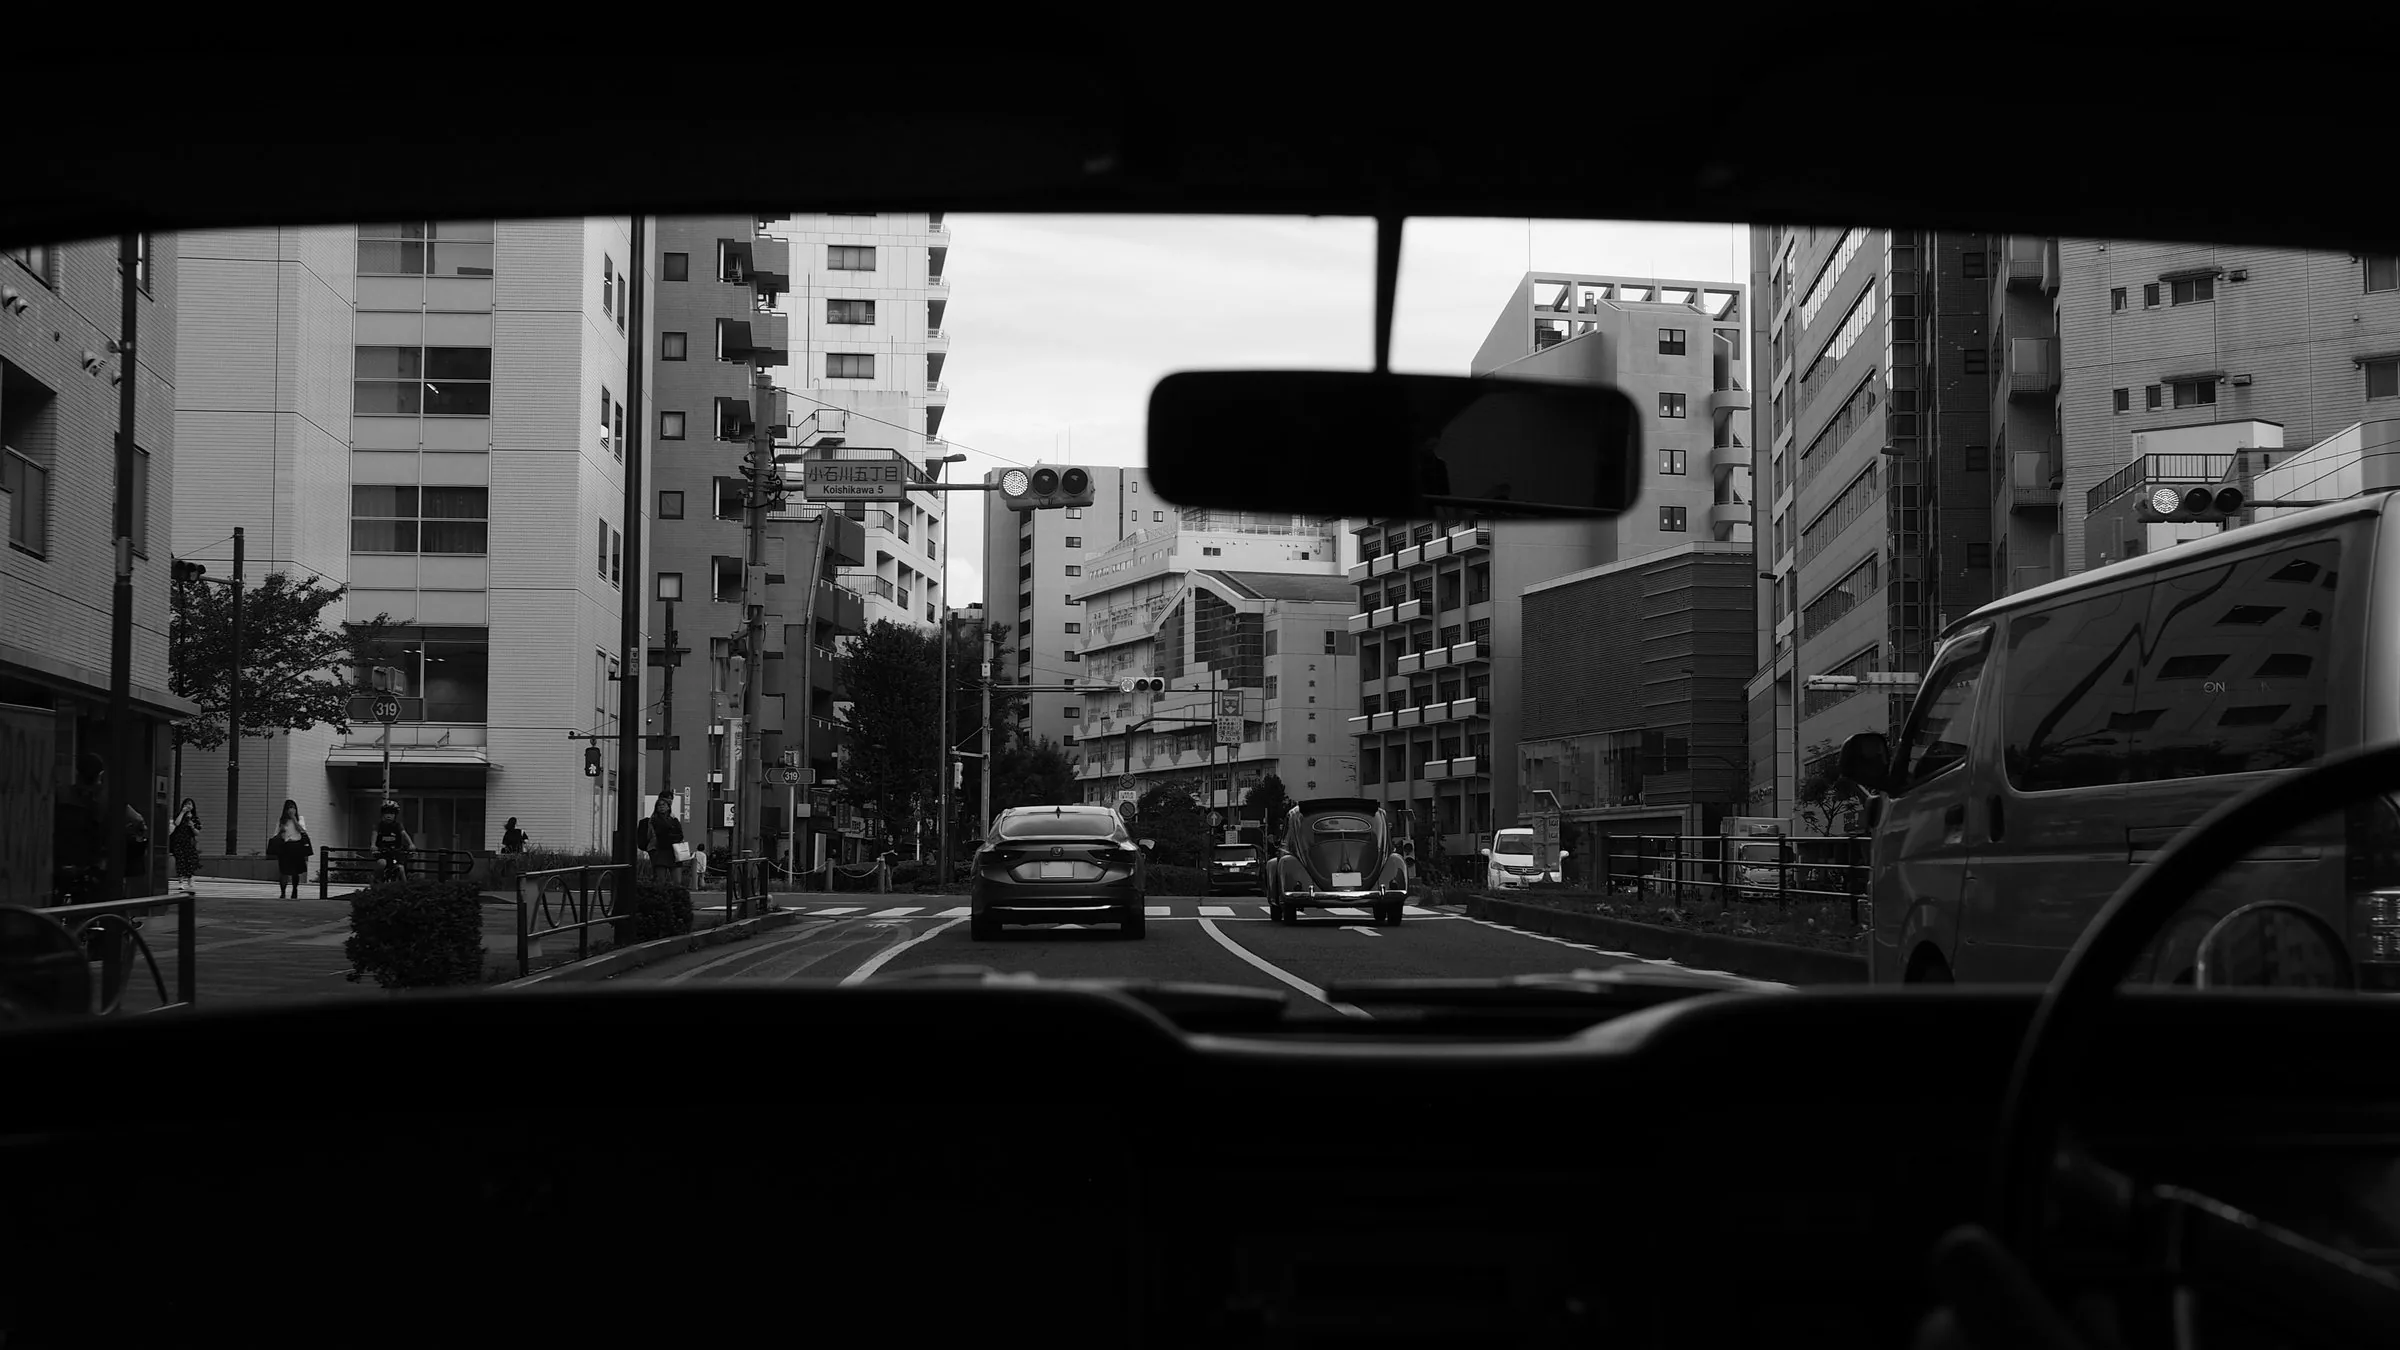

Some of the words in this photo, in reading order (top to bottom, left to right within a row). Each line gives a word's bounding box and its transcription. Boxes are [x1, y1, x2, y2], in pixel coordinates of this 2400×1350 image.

[808, 465, 898, 482] 小石川五丁目
[823, 486, 874, 495] Koishikawa
[877, 486, 884, 494] 5
[376, 702, 397, 716] 319
[784, 772, 798, 781] 319
